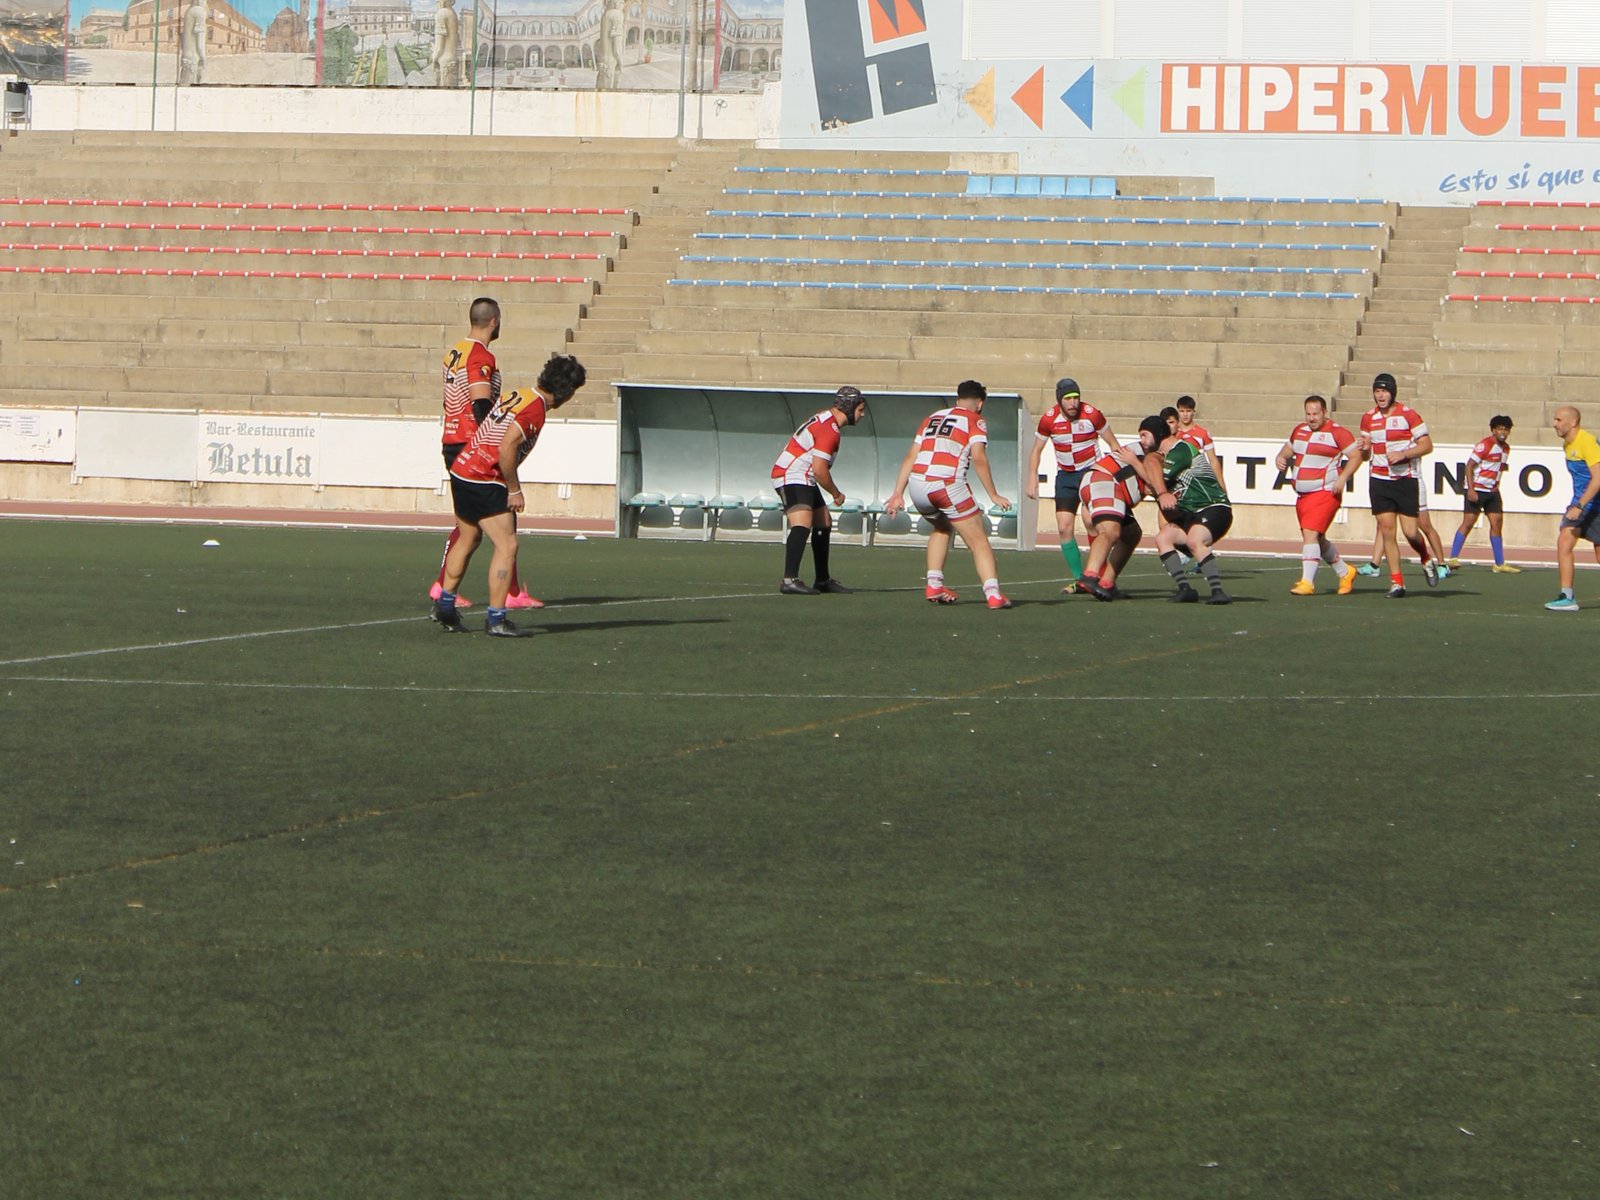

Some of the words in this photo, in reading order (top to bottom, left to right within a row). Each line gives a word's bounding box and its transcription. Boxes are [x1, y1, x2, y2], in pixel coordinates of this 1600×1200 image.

[1438, 168, 1498, 193] Esto
[1537, 168, 1585, 195] que
[205, 420, 316, 439] Bar-Restaurante
[924, 417, 958, 437] 56
[206, 441, 313, 478] Betula
